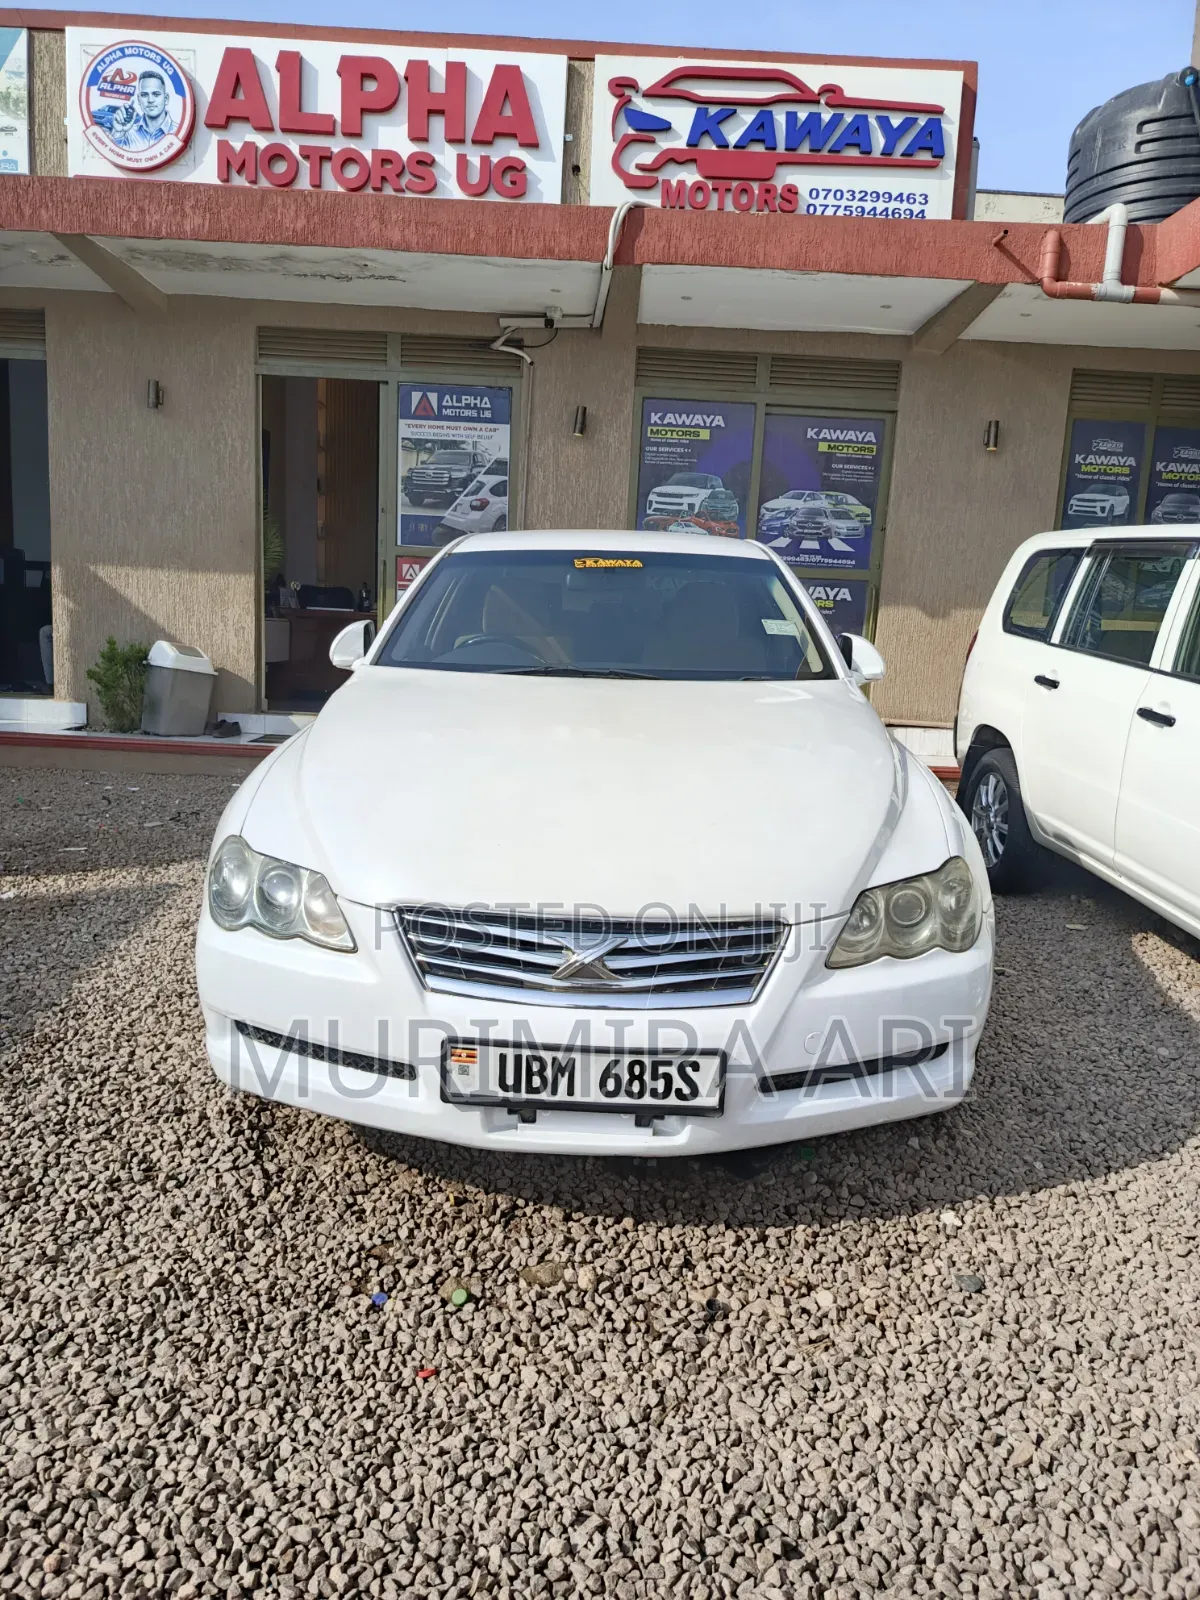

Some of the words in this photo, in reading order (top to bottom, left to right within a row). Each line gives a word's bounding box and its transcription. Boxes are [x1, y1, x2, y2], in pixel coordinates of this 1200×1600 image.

[96, 51, 122, 71] ALPHA
[124, 47, 162, 63] MOTORS
[162, 61, 175, 75] UG
[99, 82, 135, 94] ALPHA
[204, 46, 539, 147] ALPHA
[686, 106, 945, 158] KAWAYA
[108, 147, 125, 160] HOME
[126, 155, 143, 163] MUST
[163, 141, 175, 153] CAR
[217, 139, 437, 194] MOTORS
[456, 153, 527, 198] UG
[660, 178, 799, 213] MOTORS
[808, 187, 929, 205] 0703299463
[806, 203, 927, 219] 0775944694
[442, 394, 491, 408] ALPHA
[442, 408, 477, 417] MOTORS
[480, 410, 492, 418] UG
[650, 412, 726, 427] KAWAYA
[649, 428, 701, 438] MOTORS
[806, 428, 876, 442] KAWAYA
[827, 444, 875, 454] MOTORS
[1074, 453, 1136, 467] KAWAYA
[1081, 465, 1130, 474] MOTORS
[586, 559, 643, 568] KAWAYA
[498, 1052, 576, 1097] UBM
[599, 1058, 700, 1102] 685S
